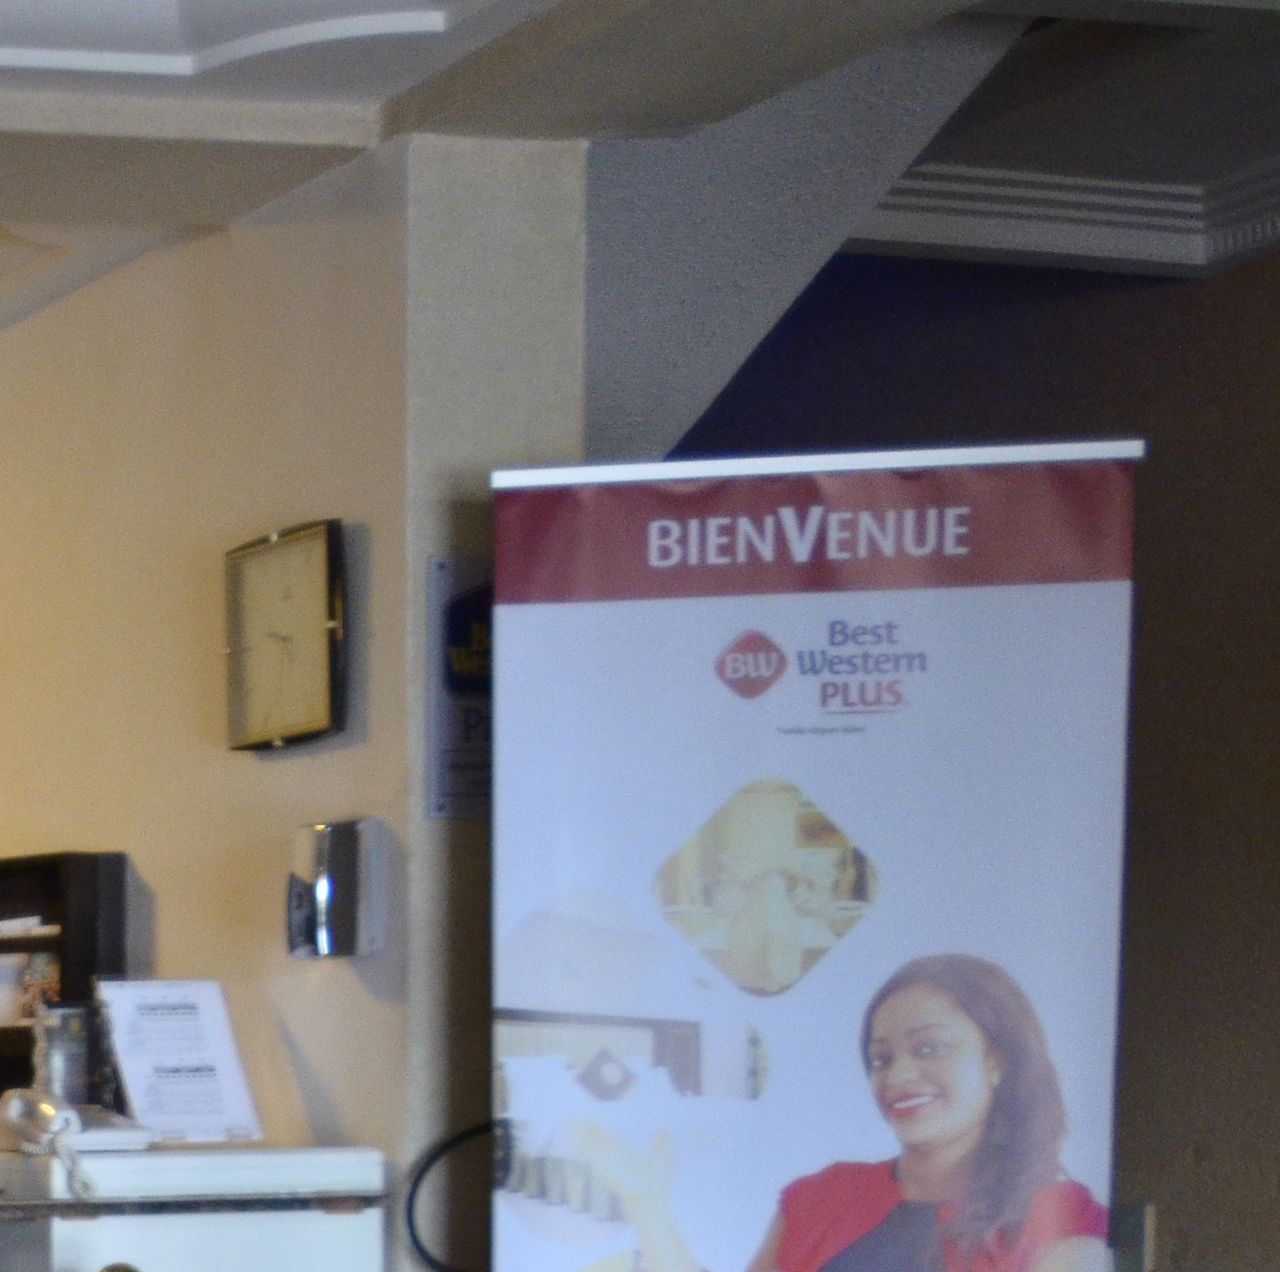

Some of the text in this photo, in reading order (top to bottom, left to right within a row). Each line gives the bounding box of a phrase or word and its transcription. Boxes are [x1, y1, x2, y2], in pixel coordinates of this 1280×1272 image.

[647, 504, 972, 569] BIENVENUE
[828, 620, 898, 646] Best
[724, 650, 779, 680] BW
[797, 649, 928, 676] Western
[820, 680, 904, 709] PLUS
